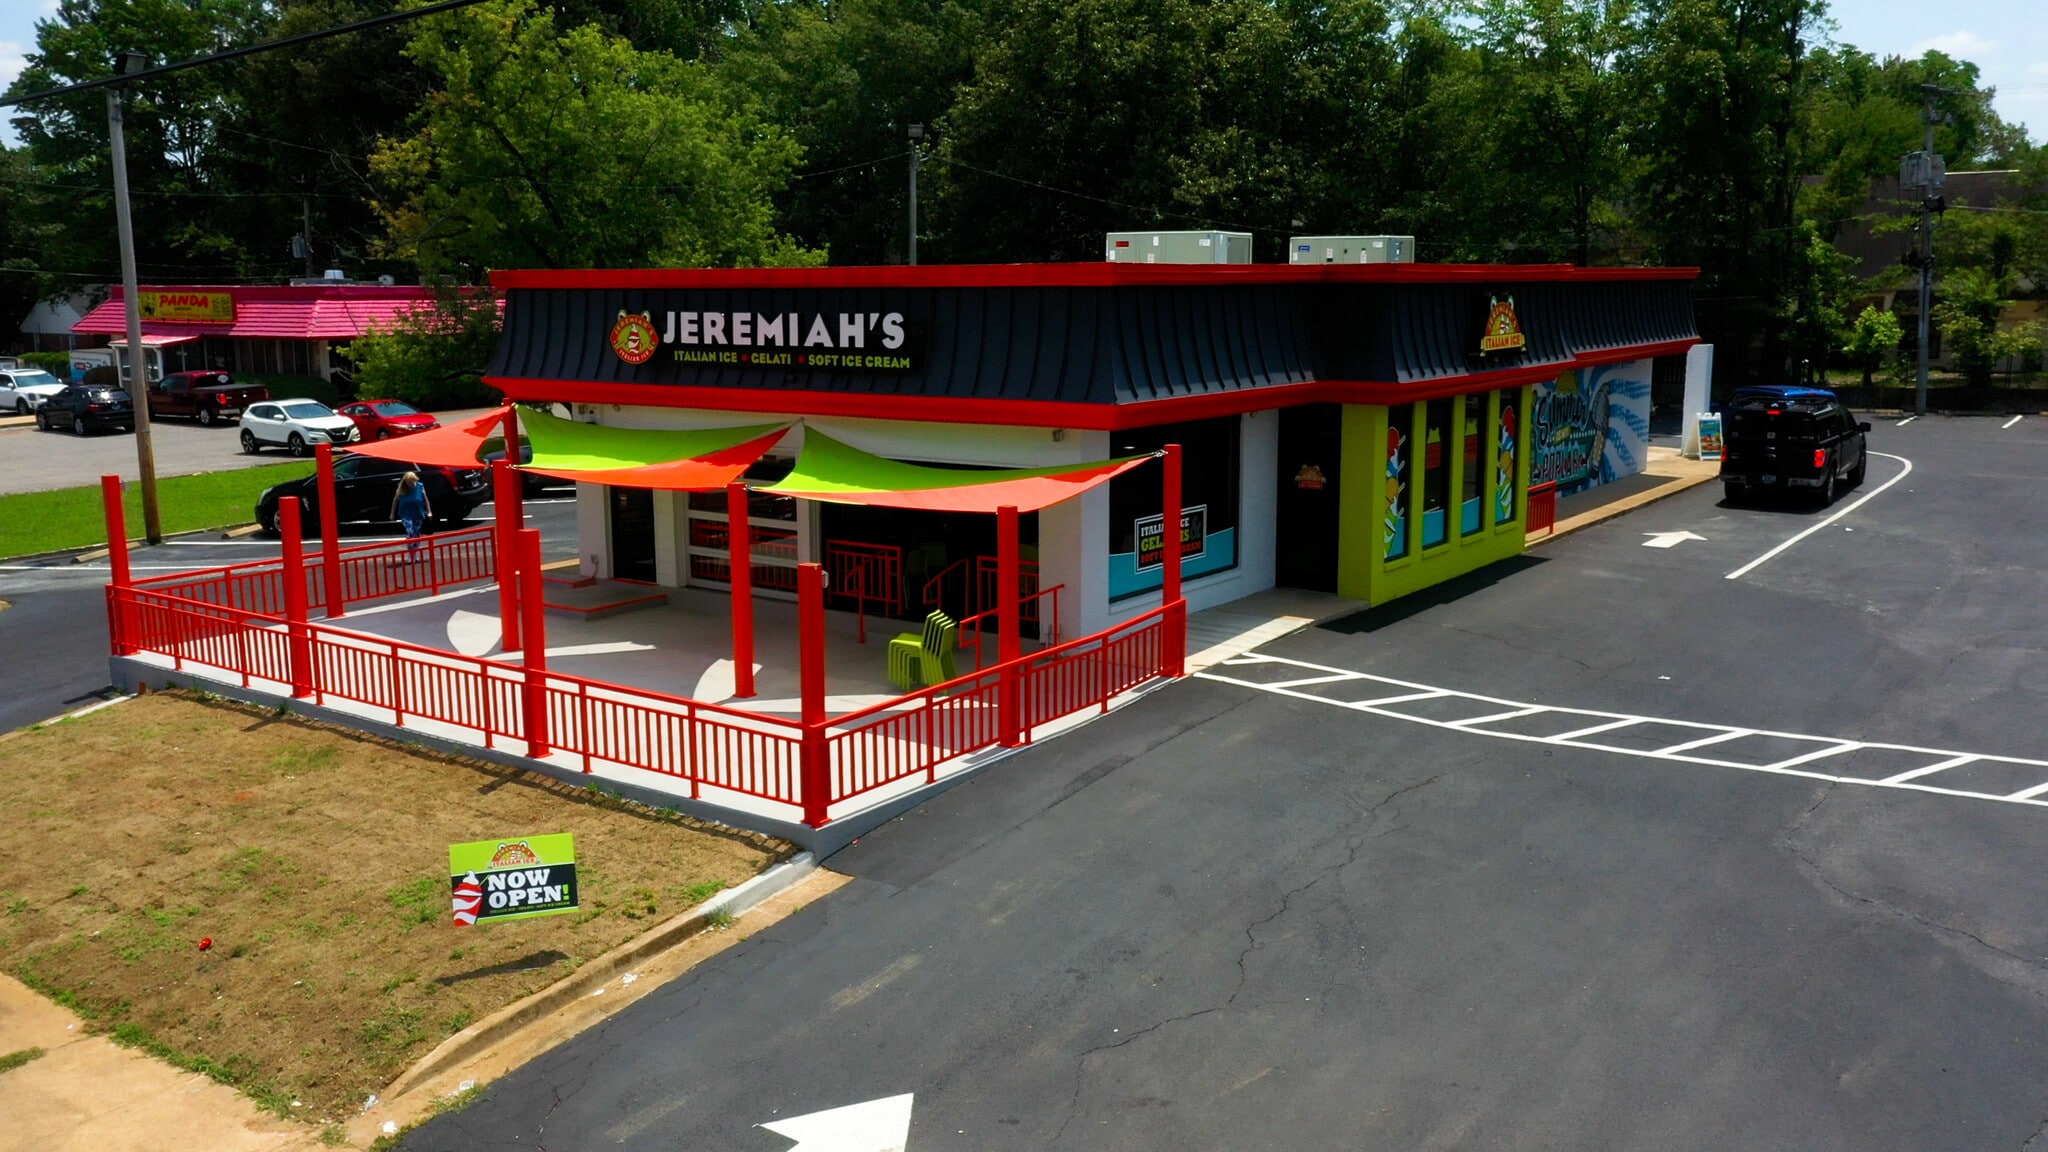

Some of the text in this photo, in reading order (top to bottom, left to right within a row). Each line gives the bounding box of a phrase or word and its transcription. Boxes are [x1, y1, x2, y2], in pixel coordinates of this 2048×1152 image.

[159, 294, 209, 308] PANDA
[662, 311, 905, 350] JEREMIAH'S
[674, 350, 910, 369] ITALIAN ICE GELATI SOFT ICE CREAM
[1140, 523, 1164, 537] ITALI
[487, 868, 551, 891] NOW
[488, 884, 569, 908] OPEN!
